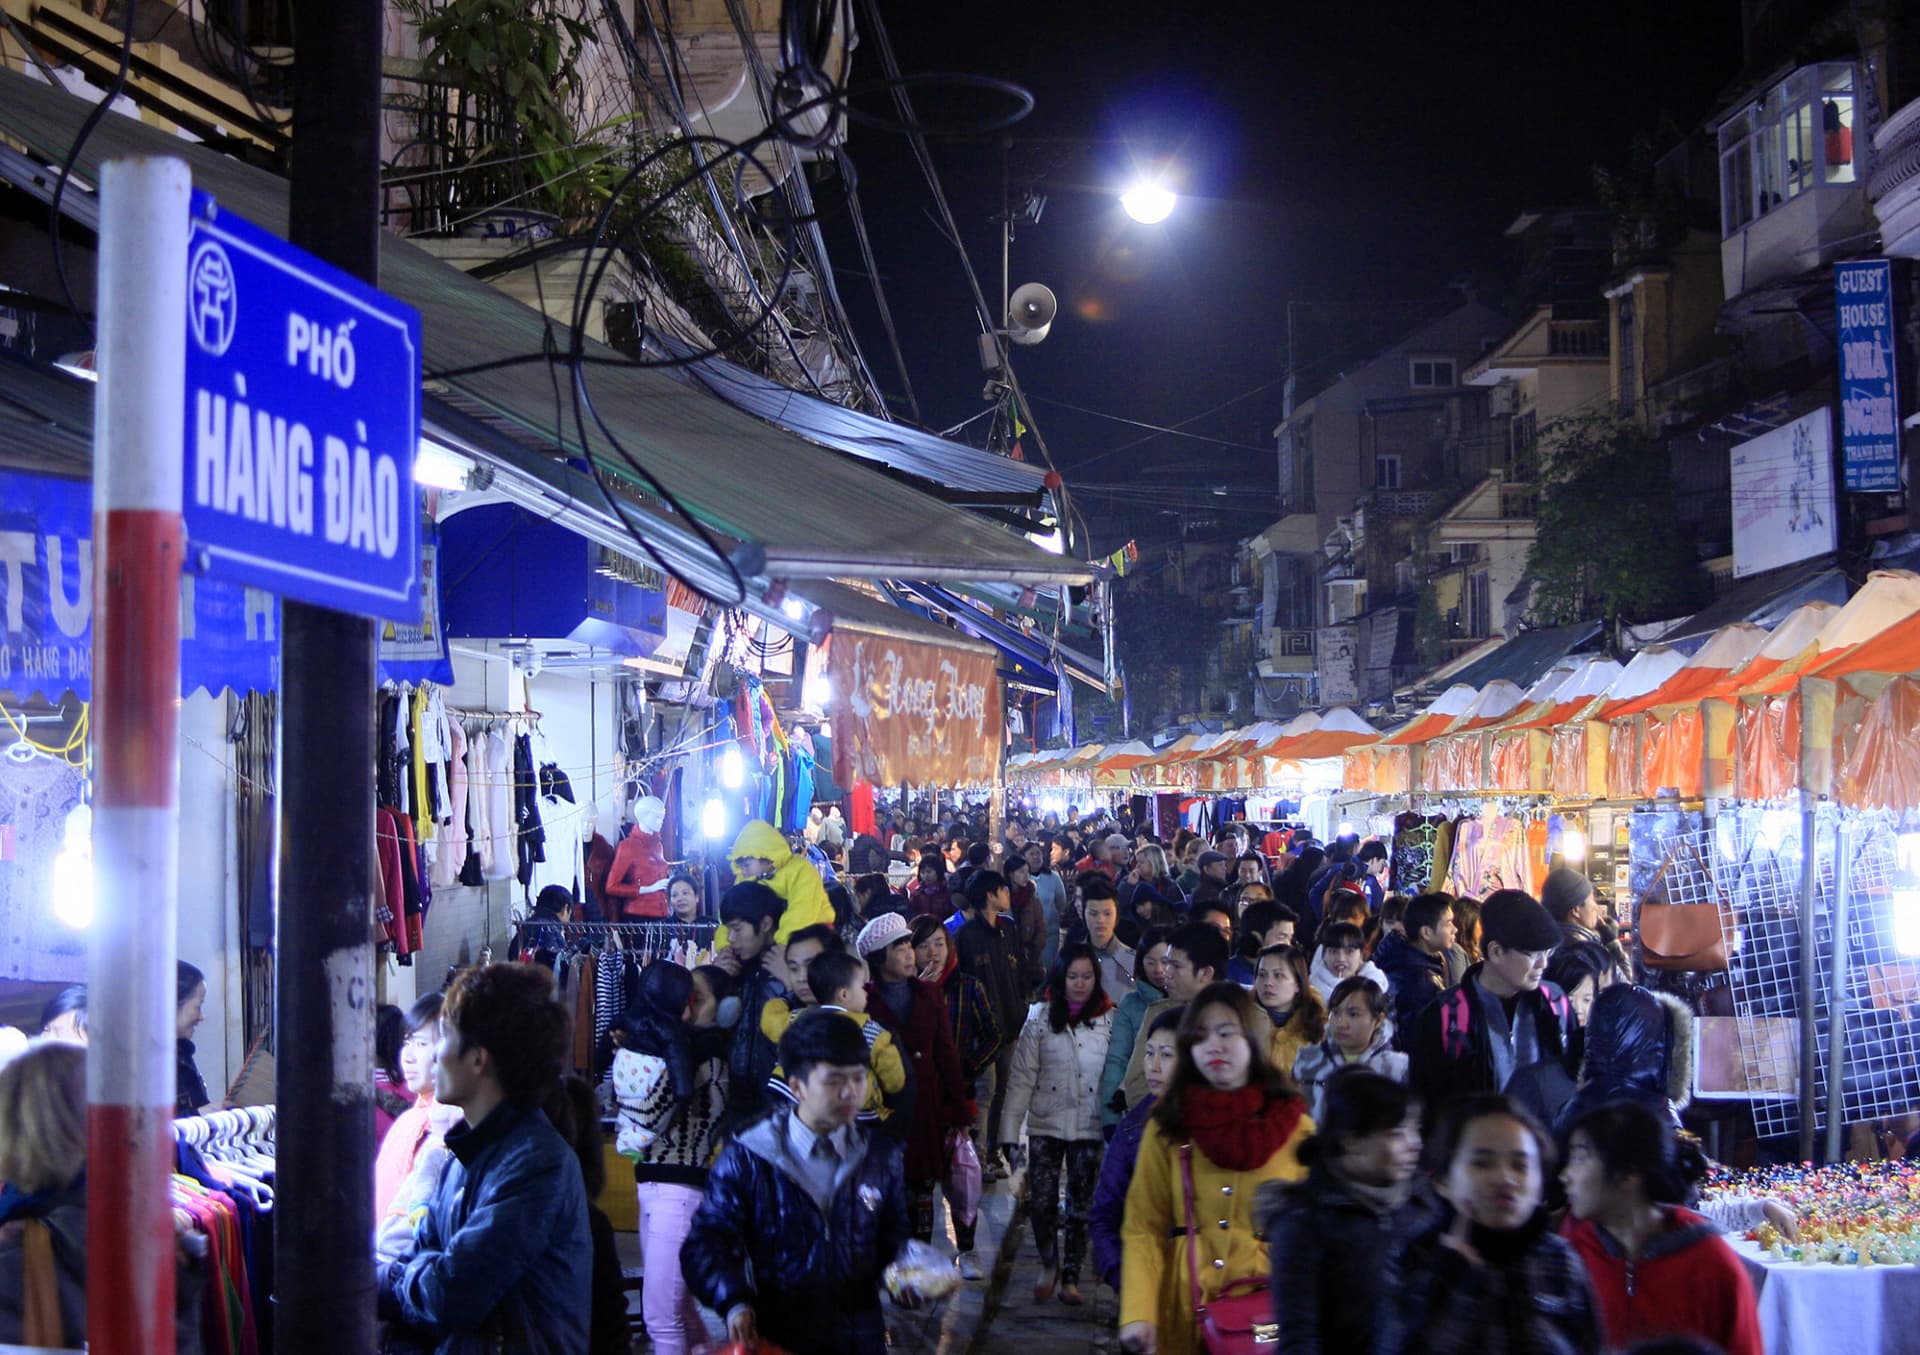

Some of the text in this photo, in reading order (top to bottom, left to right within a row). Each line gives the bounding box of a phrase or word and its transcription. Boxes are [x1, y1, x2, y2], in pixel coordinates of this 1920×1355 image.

[1839, 268, 1884, 293] GUEST
[1840, 303, 1886, 328] HOUSE
[287, 311, 357, 389] PHỐ
[196, 371, 399, 559] HÀNG ĐÀO
